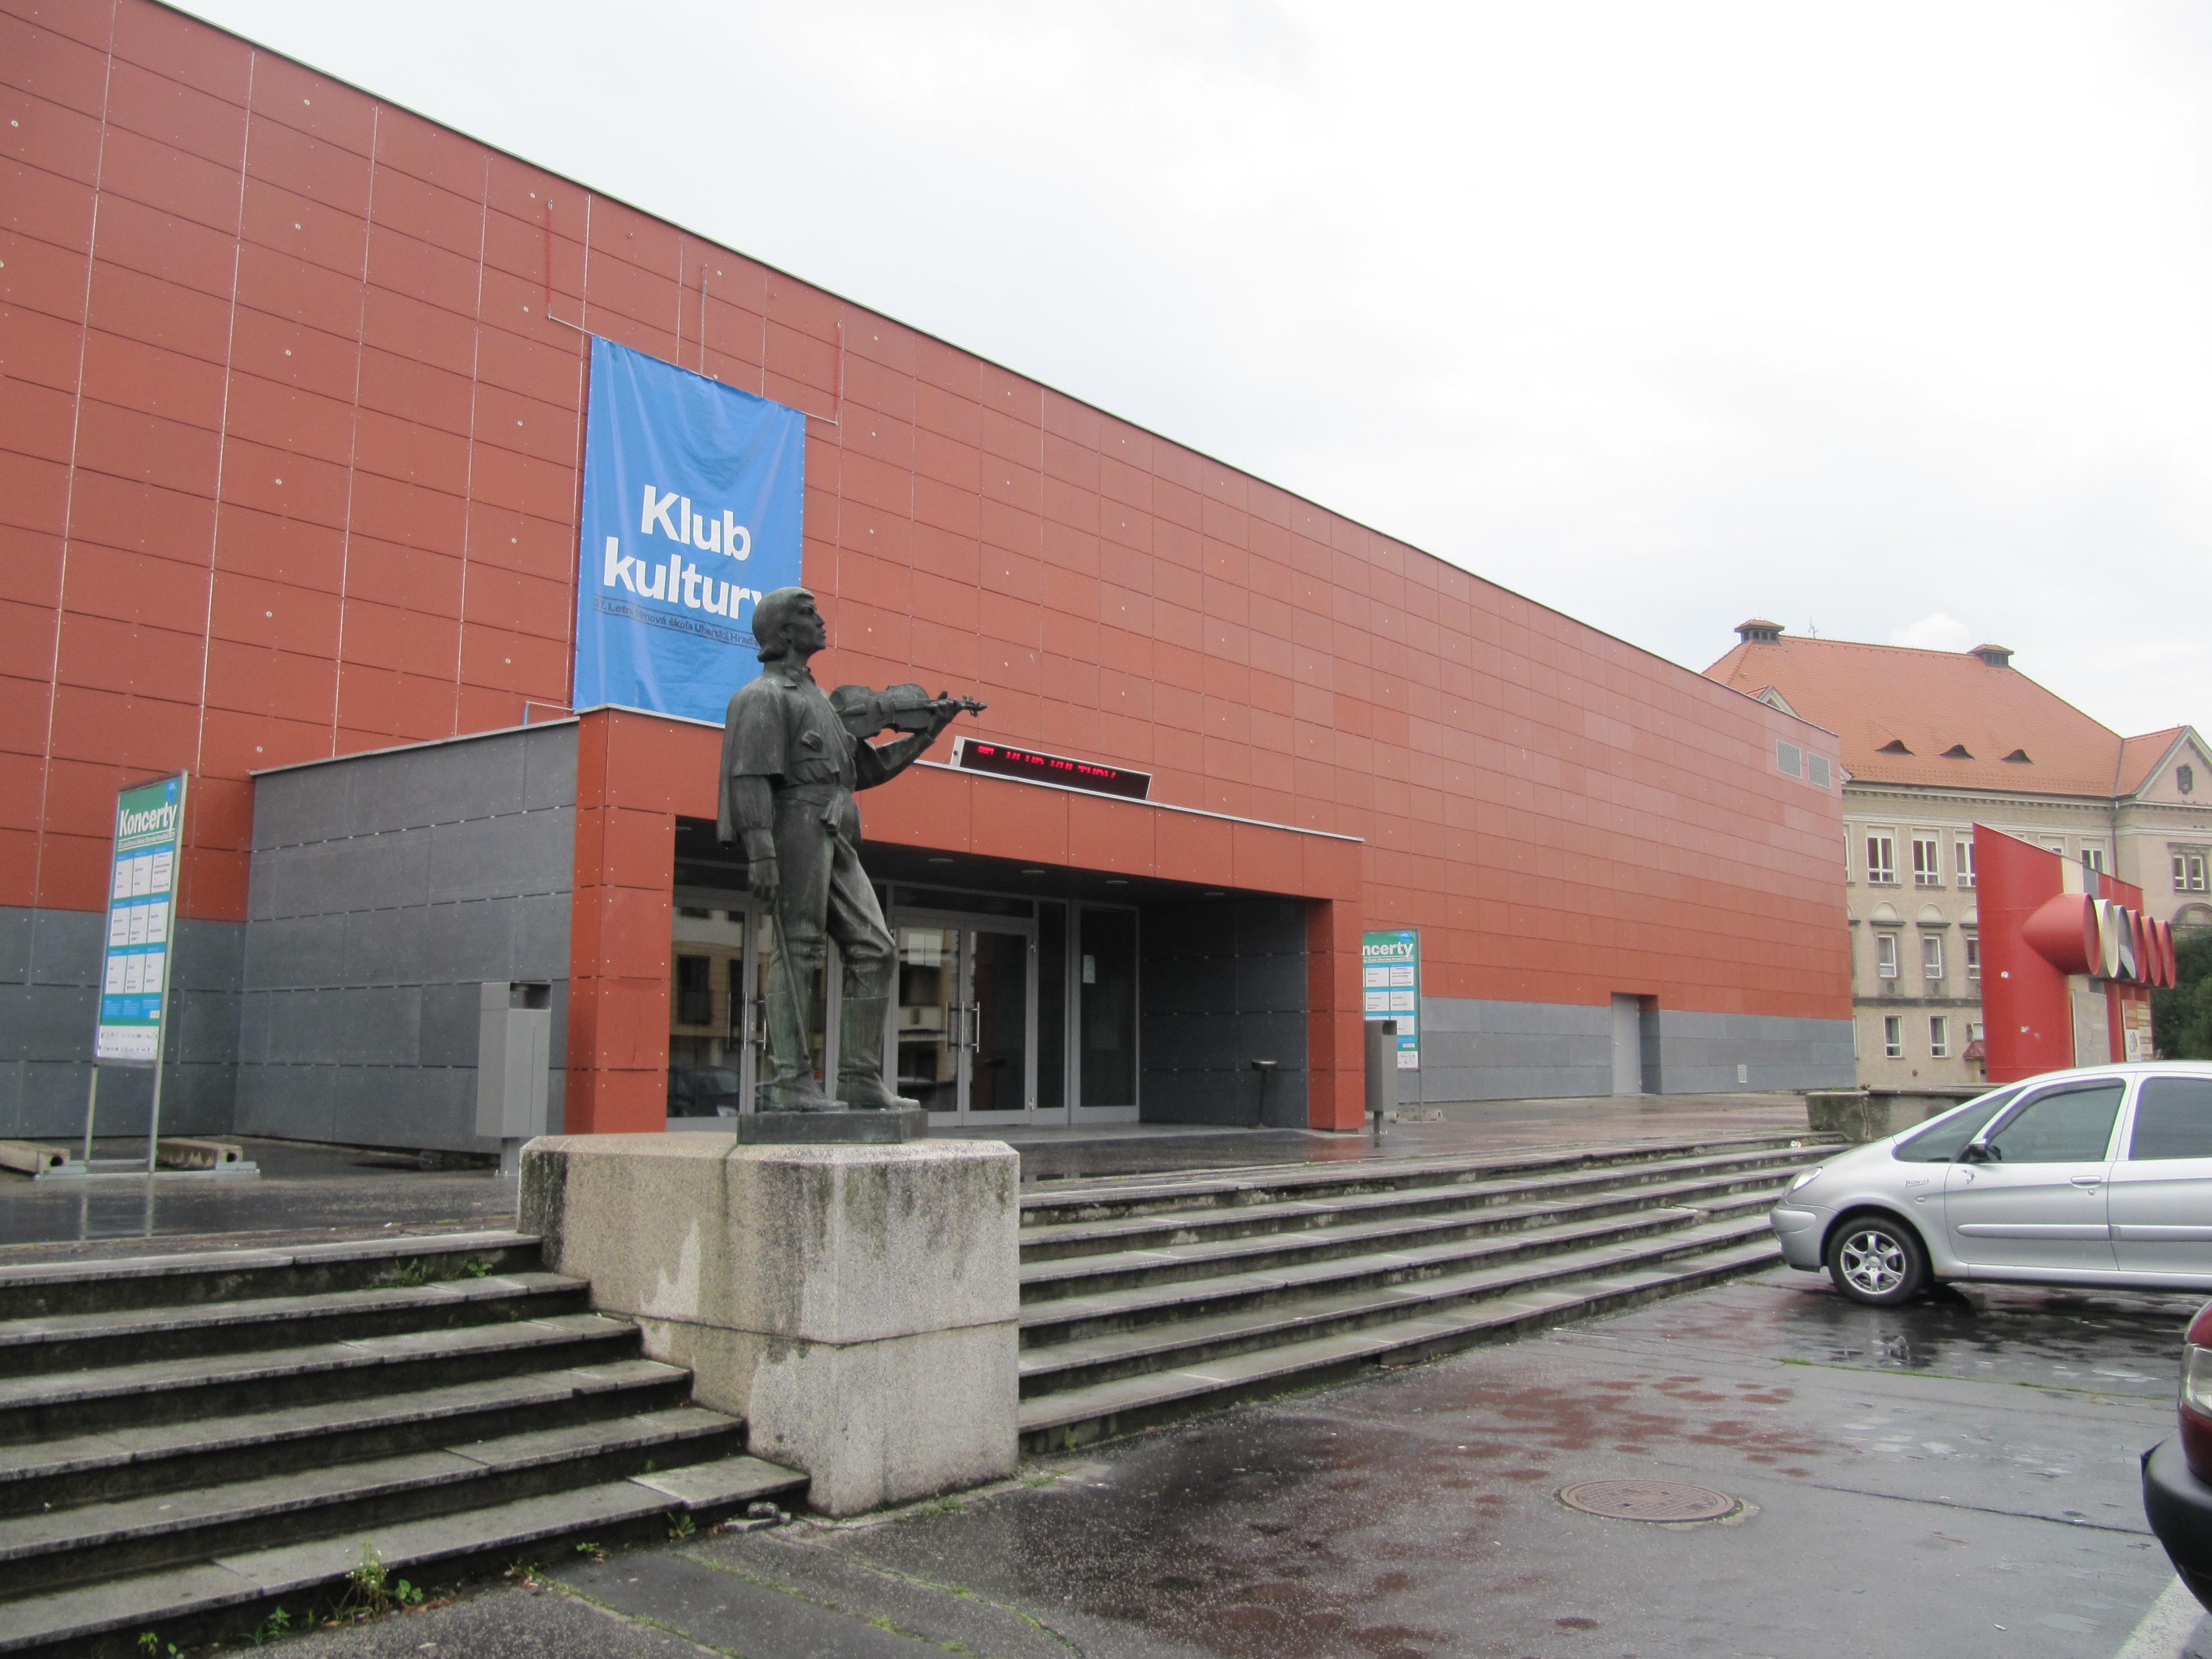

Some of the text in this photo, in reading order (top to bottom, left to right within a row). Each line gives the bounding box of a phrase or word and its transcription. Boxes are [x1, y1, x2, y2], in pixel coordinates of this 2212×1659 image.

[641, 484, 751, 561] Klub
[669, 617, 693, 632] škola
[119, 802, 178, 837] Koncerty
[1361, 941, 1413, 959] ncerty
